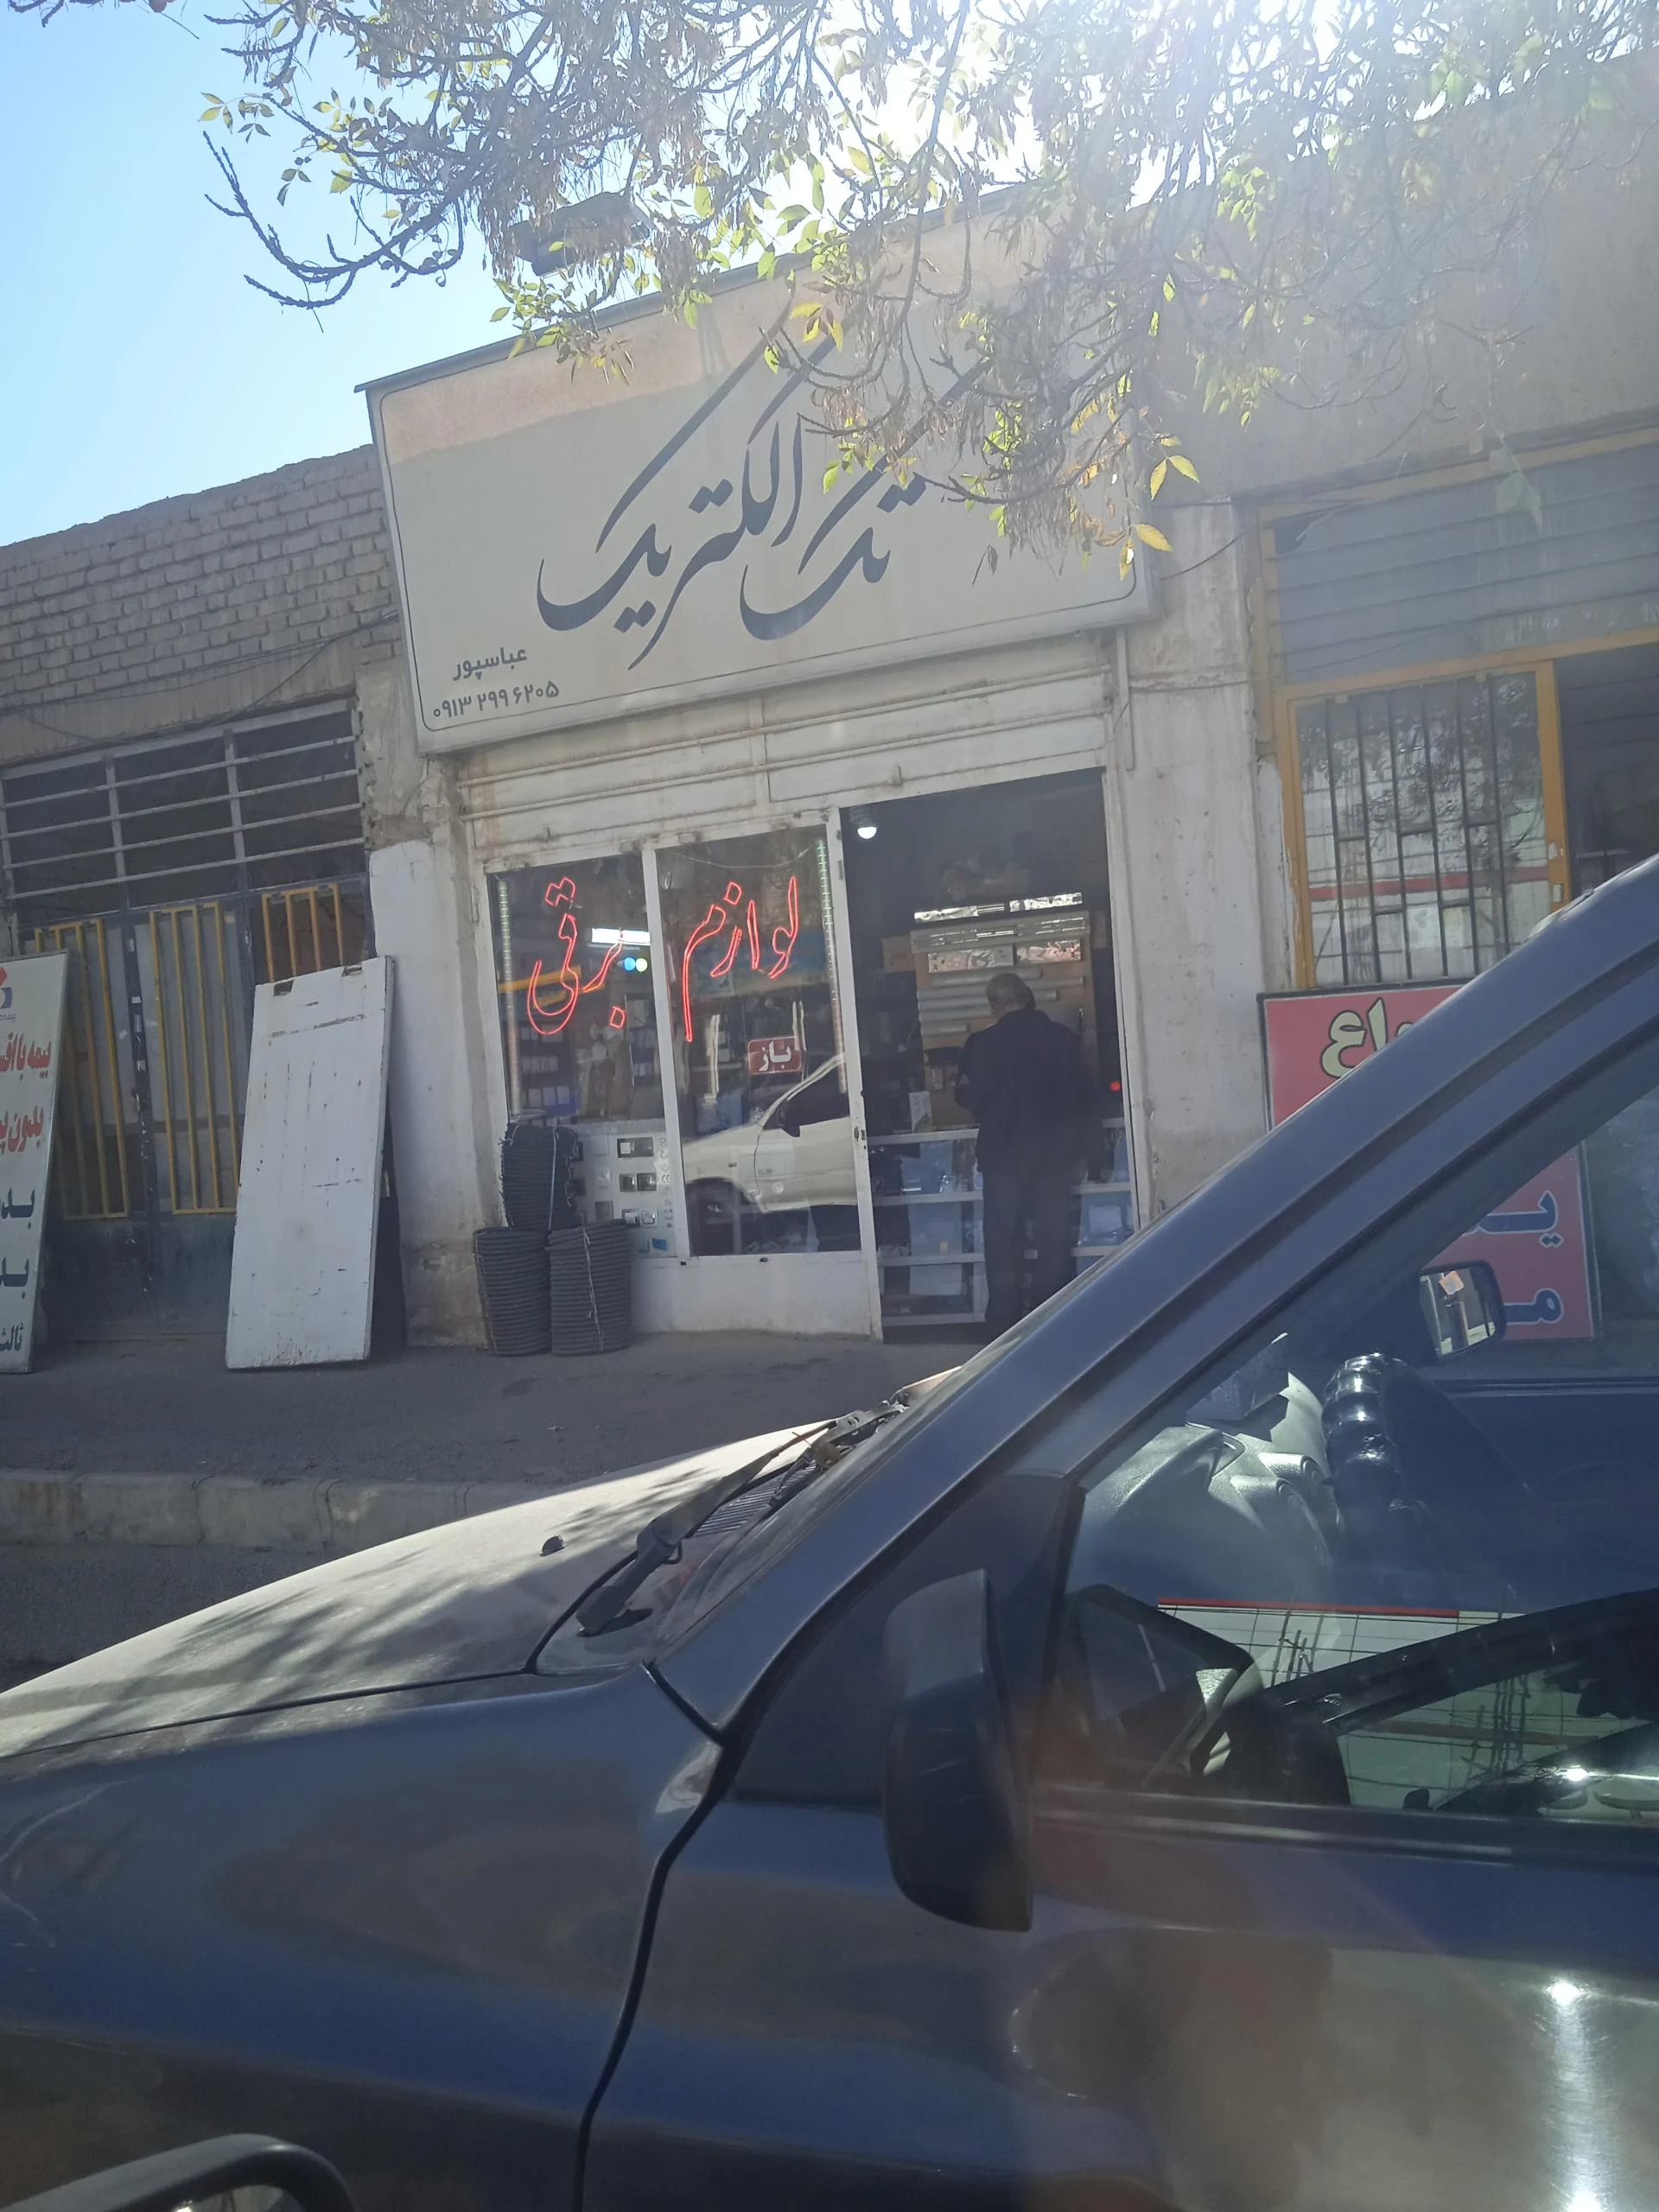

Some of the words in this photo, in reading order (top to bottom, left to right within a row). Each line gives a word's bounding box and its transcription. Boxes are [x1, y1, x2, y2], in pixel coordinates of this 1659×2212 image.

[537, 271, 887, 671] الکتریک
[452, 647, 527, 681] عباسپور
[682, 876, 799, 1043] لوازم
[758, 1040, 791, 1071] باز
